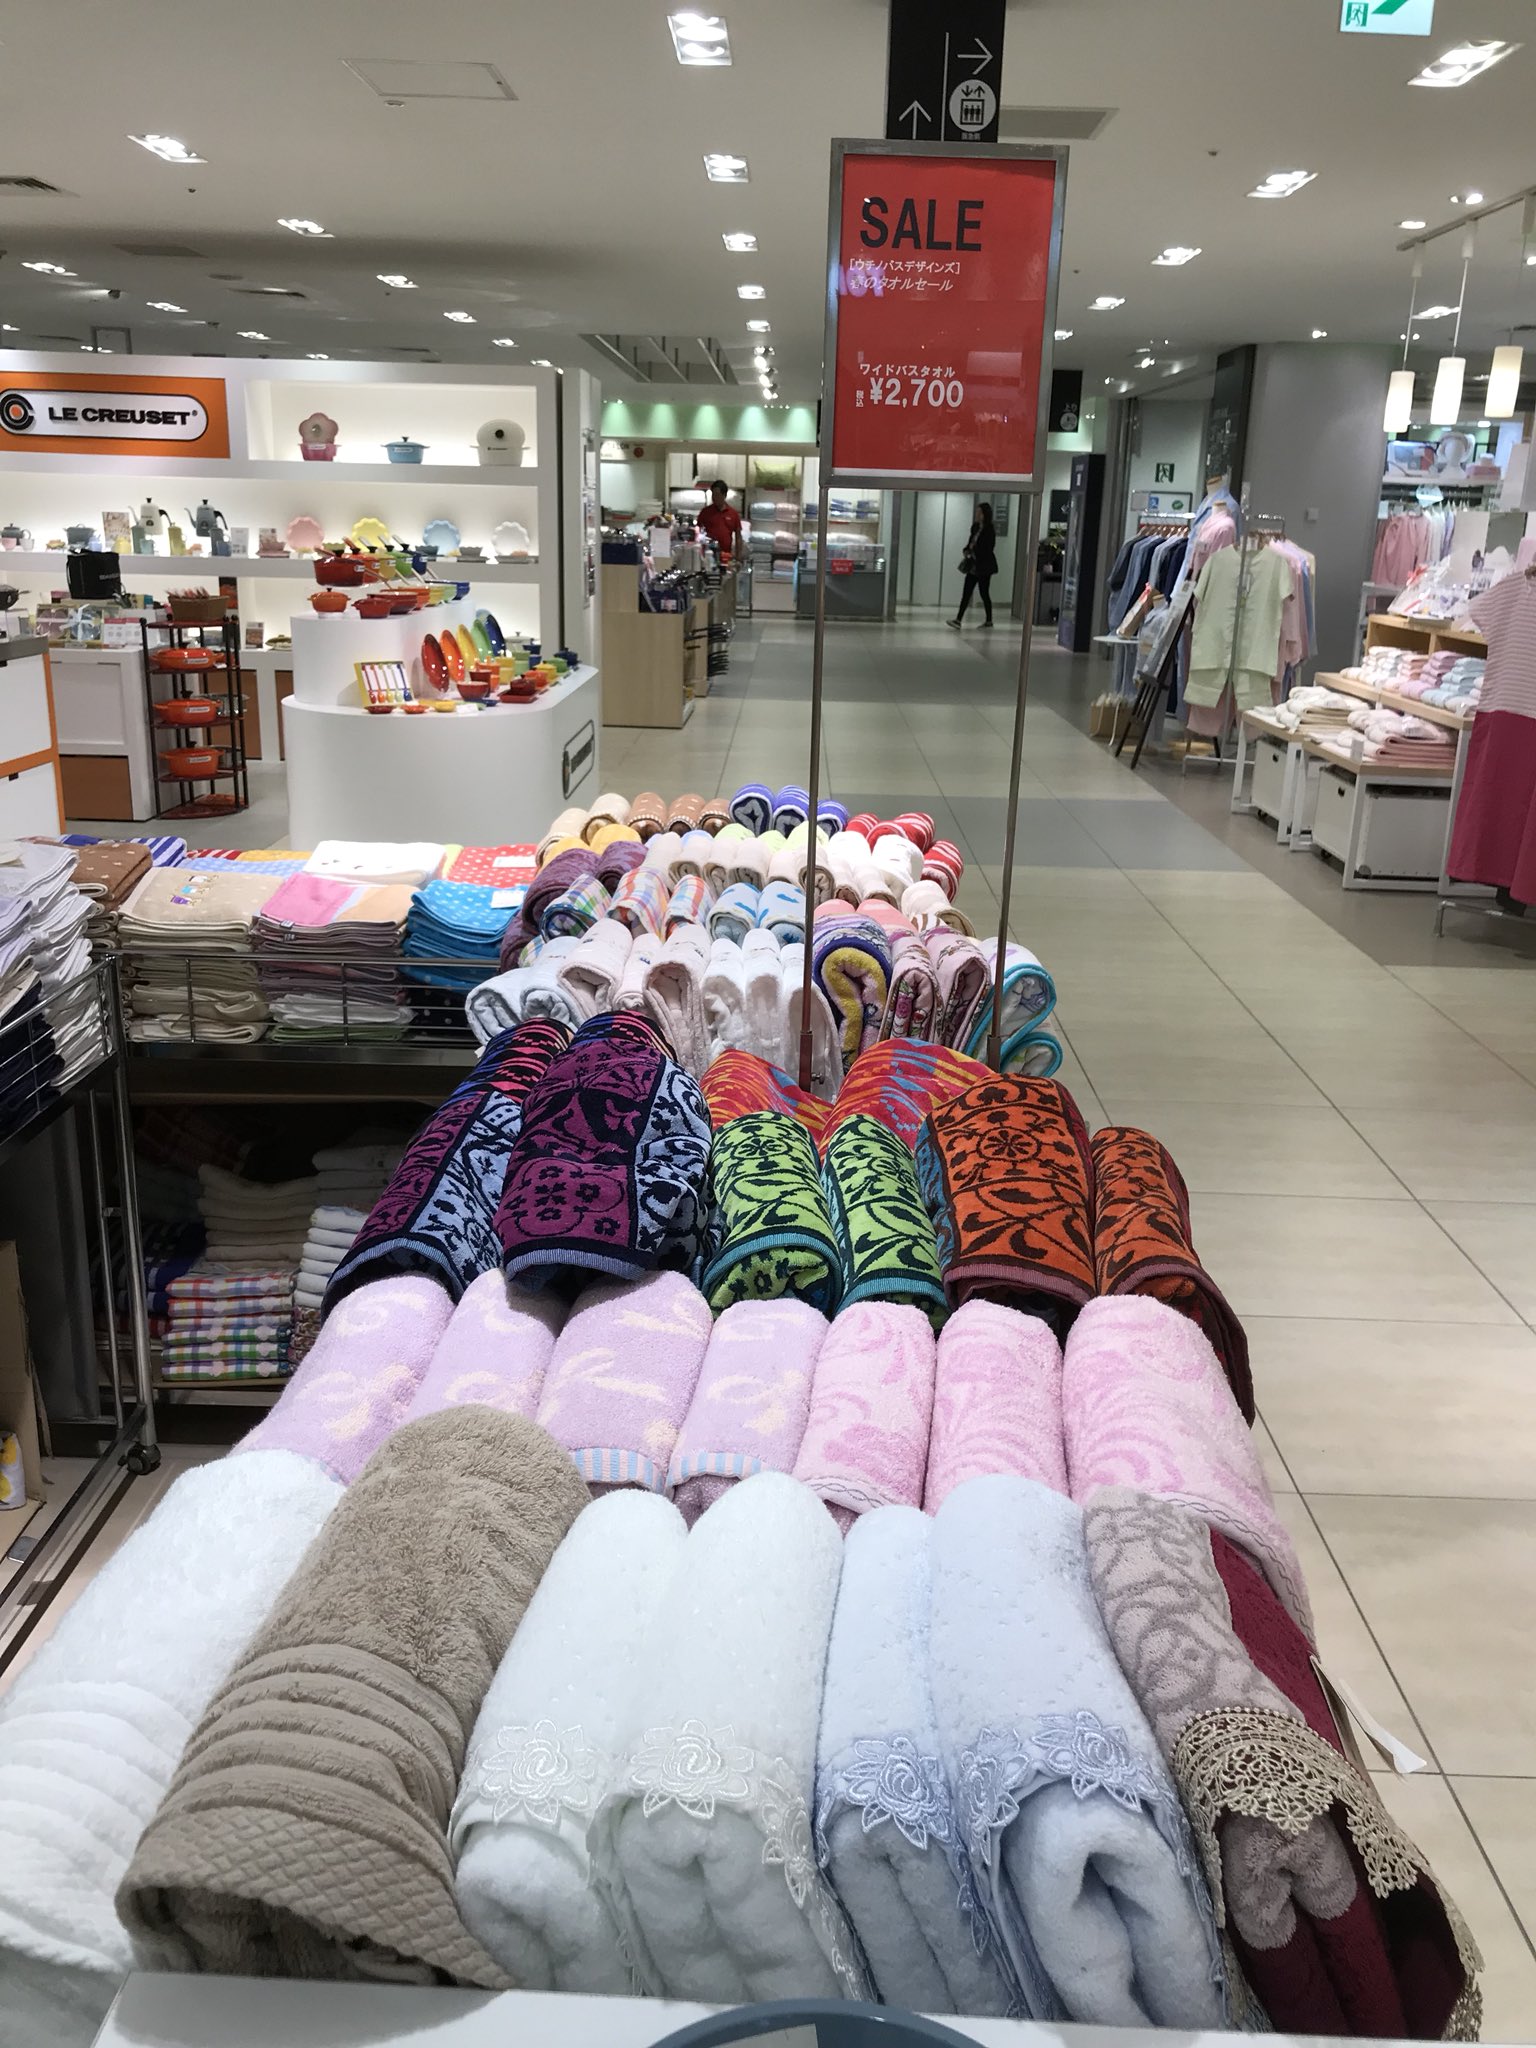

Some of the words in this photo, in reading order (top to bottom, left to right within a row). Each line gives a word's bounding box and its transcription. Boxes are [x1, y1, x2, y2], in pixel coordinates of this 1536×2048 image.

[860, 196, 984, 251] SALE
[860, 363, 955, 378] ワイドバスタオル
[870, 377, 964, 408] ¥2,700
[49, 407, 78, 421] LE
